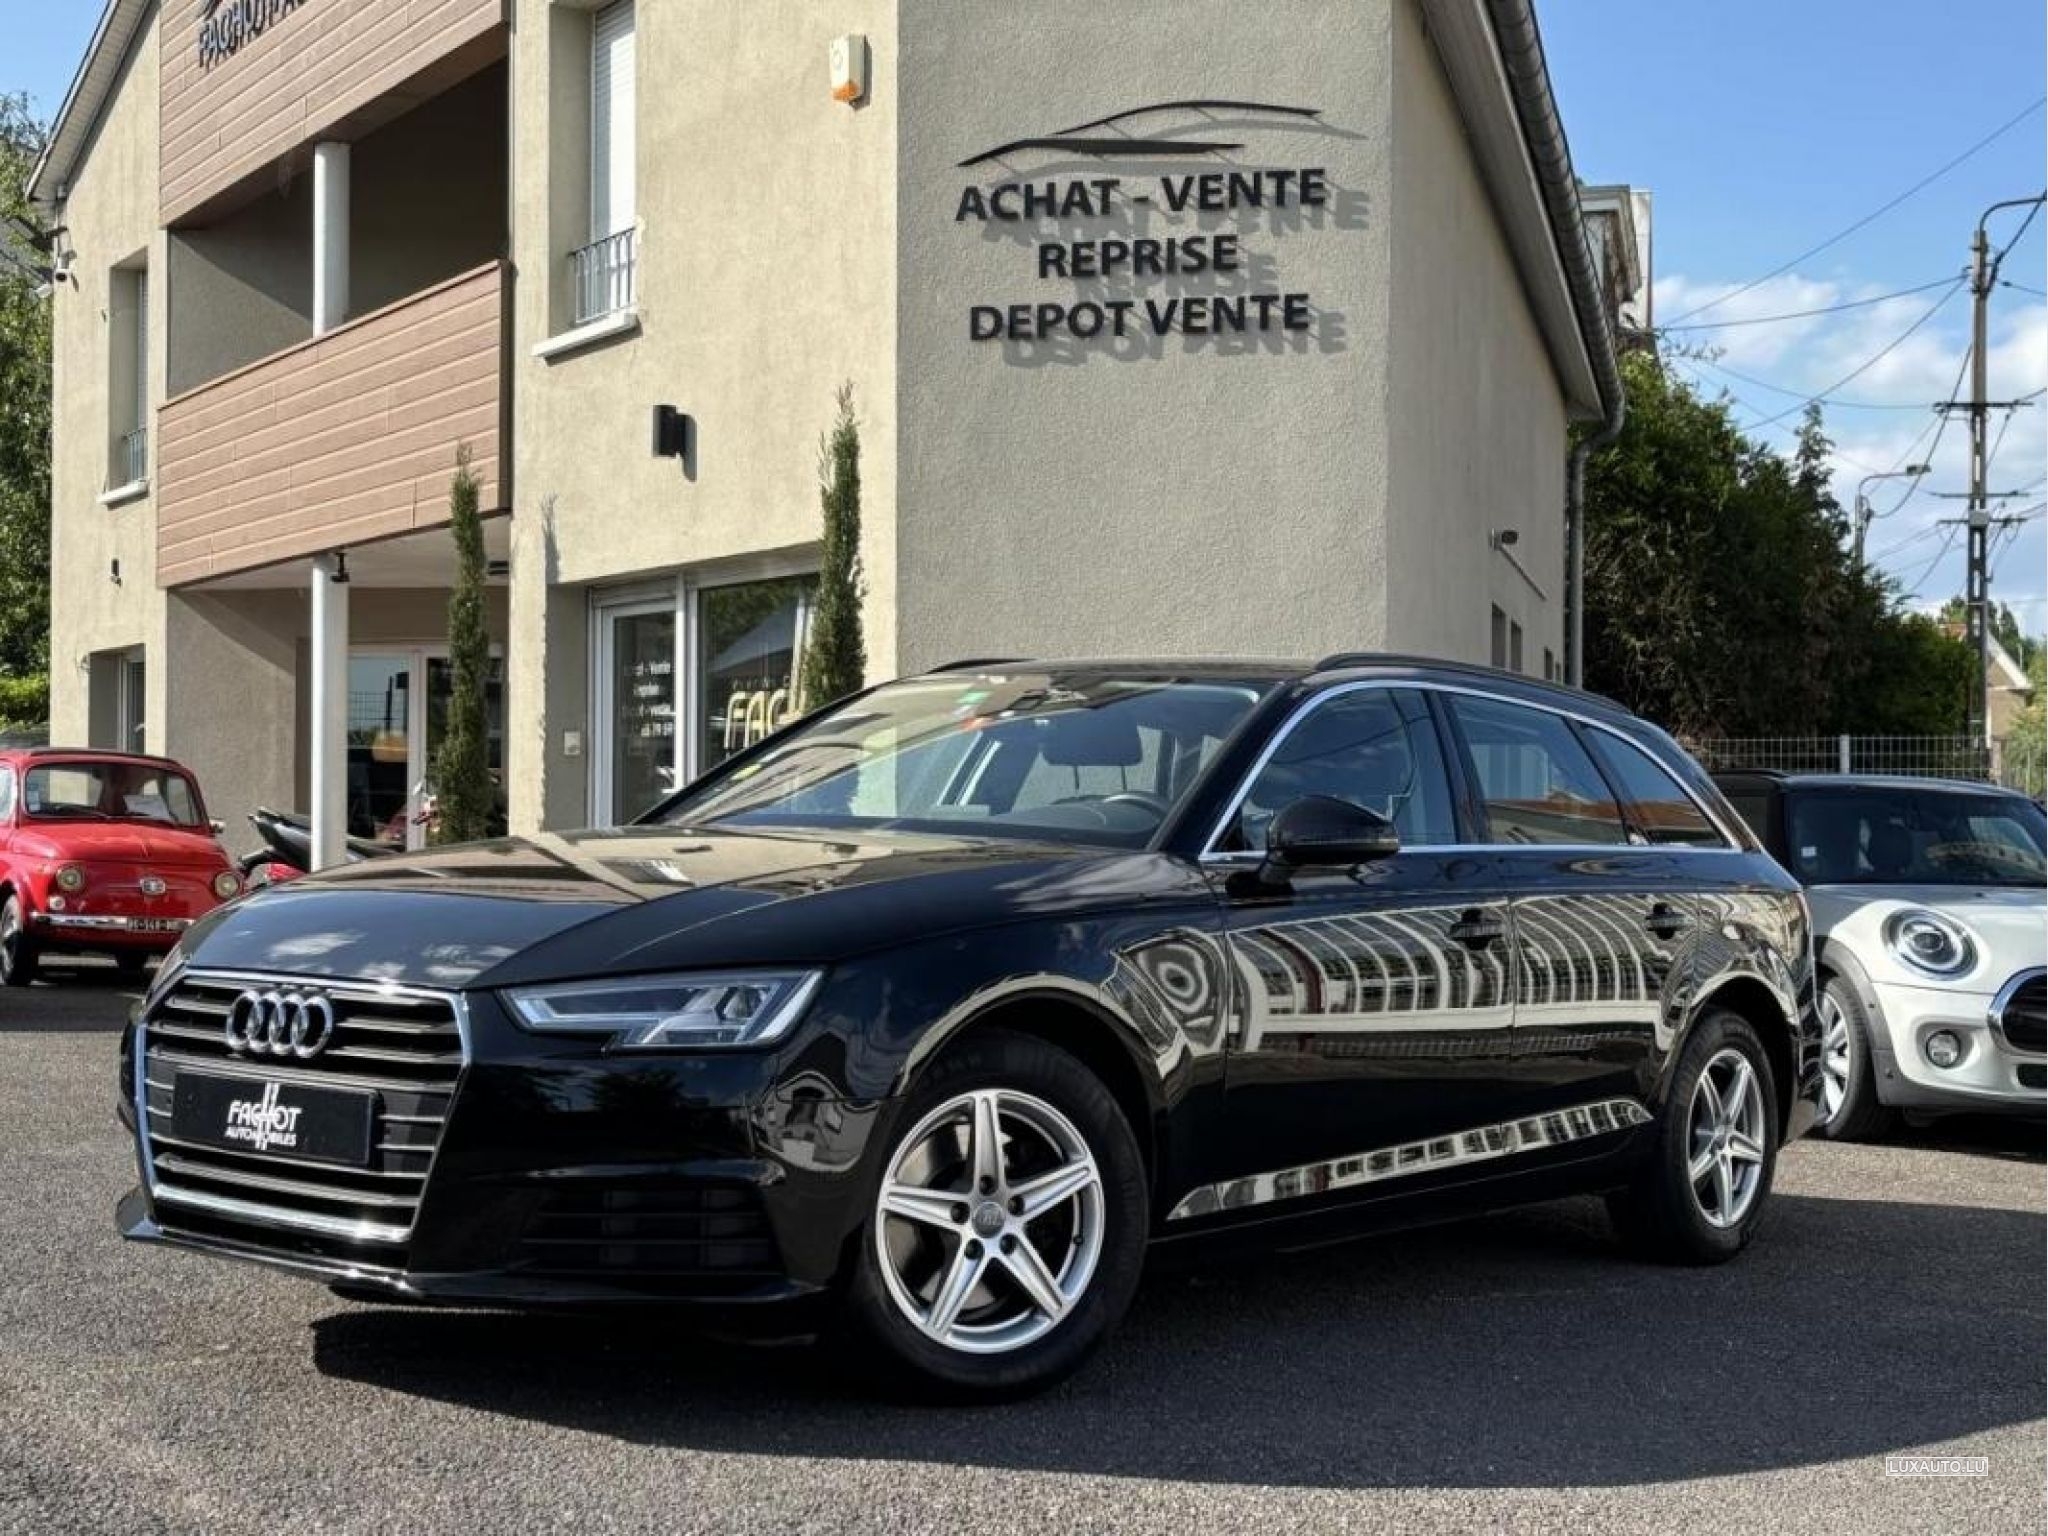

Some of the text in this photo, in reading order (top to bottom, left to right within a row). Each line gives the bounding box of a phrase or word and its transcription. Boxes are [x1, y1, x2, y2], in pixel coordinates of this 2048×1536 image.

[956, 178, 1120, 222] ACHAT
[1161, 168, 1326, 212] VENTE
[1038, 234, 1238, 279] REPRISE
[970, 293, 1309, 341] DEPOT VENTE
[227, 1090, 302, 1131] FACHOT
